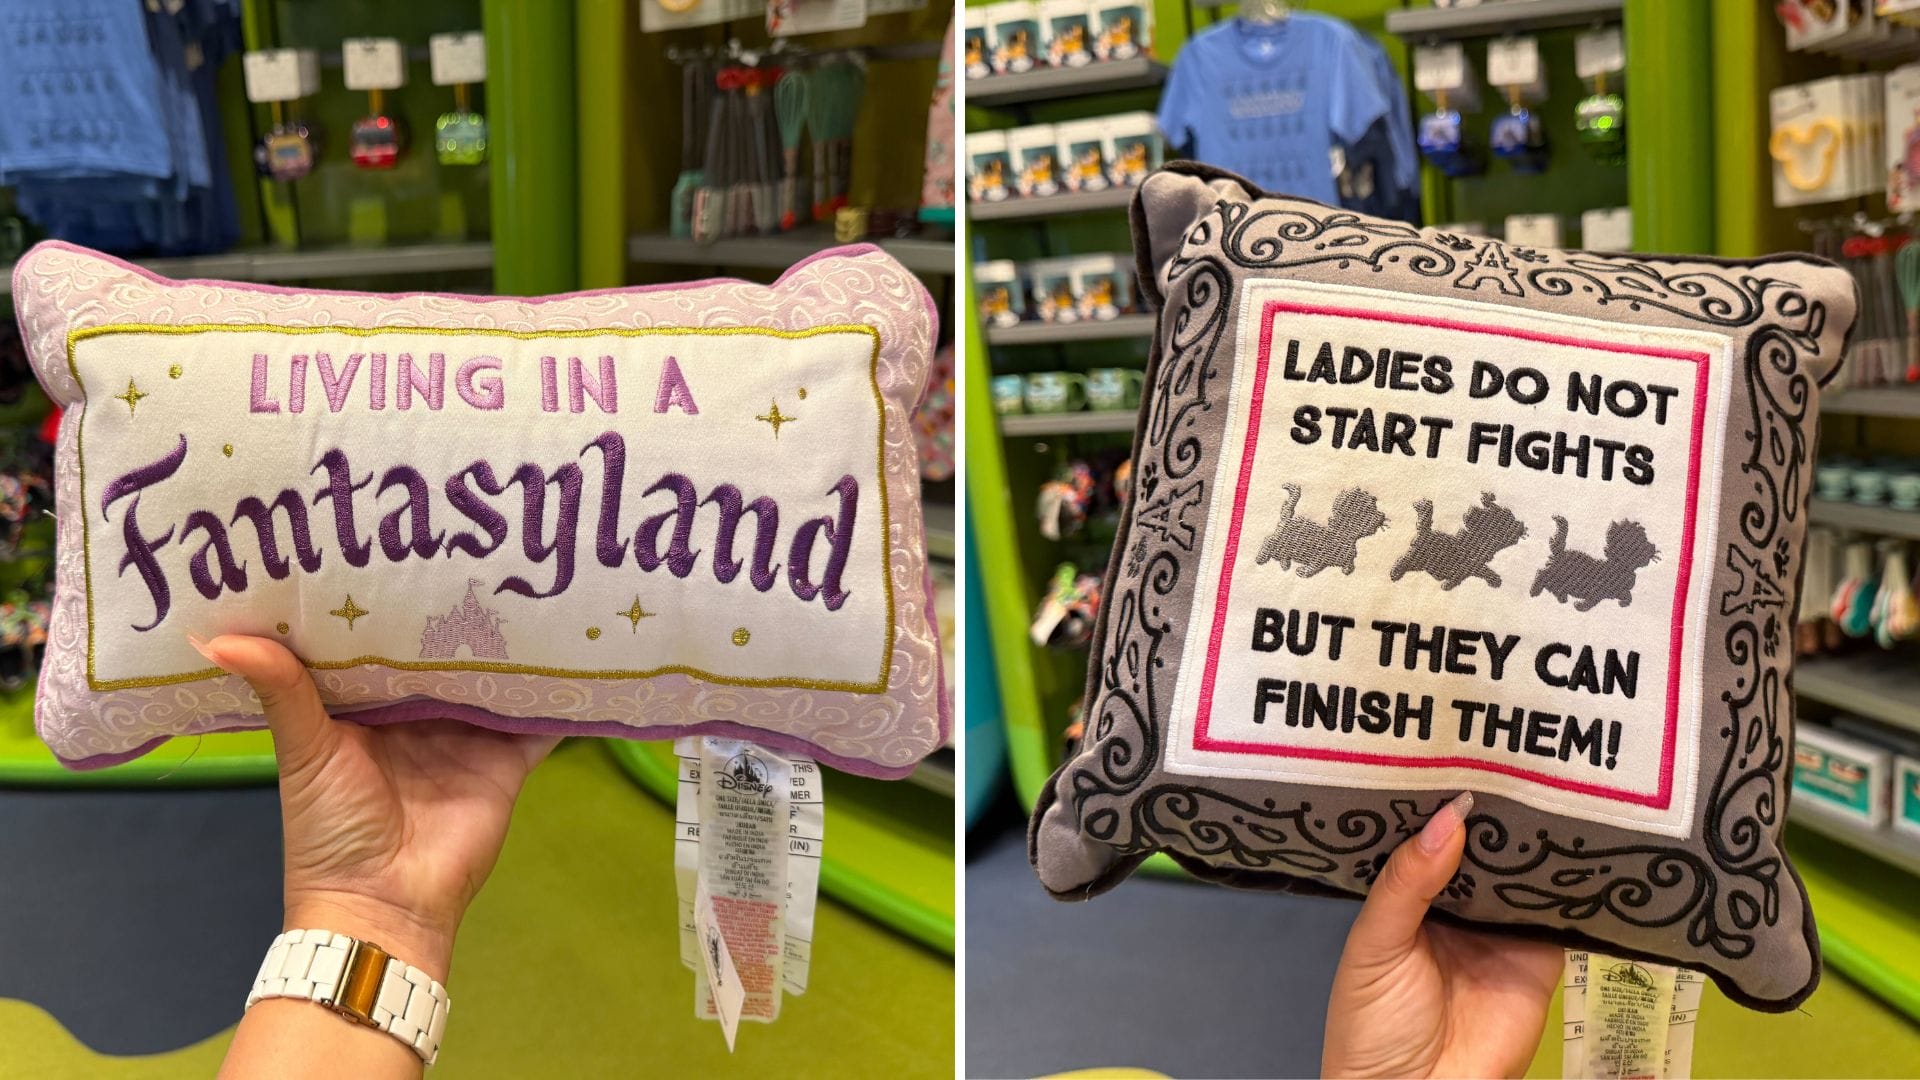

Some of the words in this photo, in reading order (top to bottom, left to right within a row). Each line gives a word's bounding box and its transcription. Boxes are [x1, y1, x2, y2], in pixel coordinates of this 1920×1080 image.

[249, 353, 505, 412] LIVING
[540, 357, 618, 413] IN
[655, 357, 699, 414] A
[1283, 338, 1454, 395] LADIES
[1468, 359, 1550, 405] DO
[1566, 371, 1680, 426] NOT
[1289, 404, 1454, 459] START
[1466, 422, 1656, 487] FIGHTS
[101, 432, 860, 627] Fantasyland
[1251, 606, 1358, 661] BUT
[1371, 620, 1521, 681] THEY
[1534, 642, 1641, 699] CAN
[792, 763, 814, 773] THIS
[1252, 676, 1435, 742] FINISH
[1450, 699, 1623, 772] THEM!
